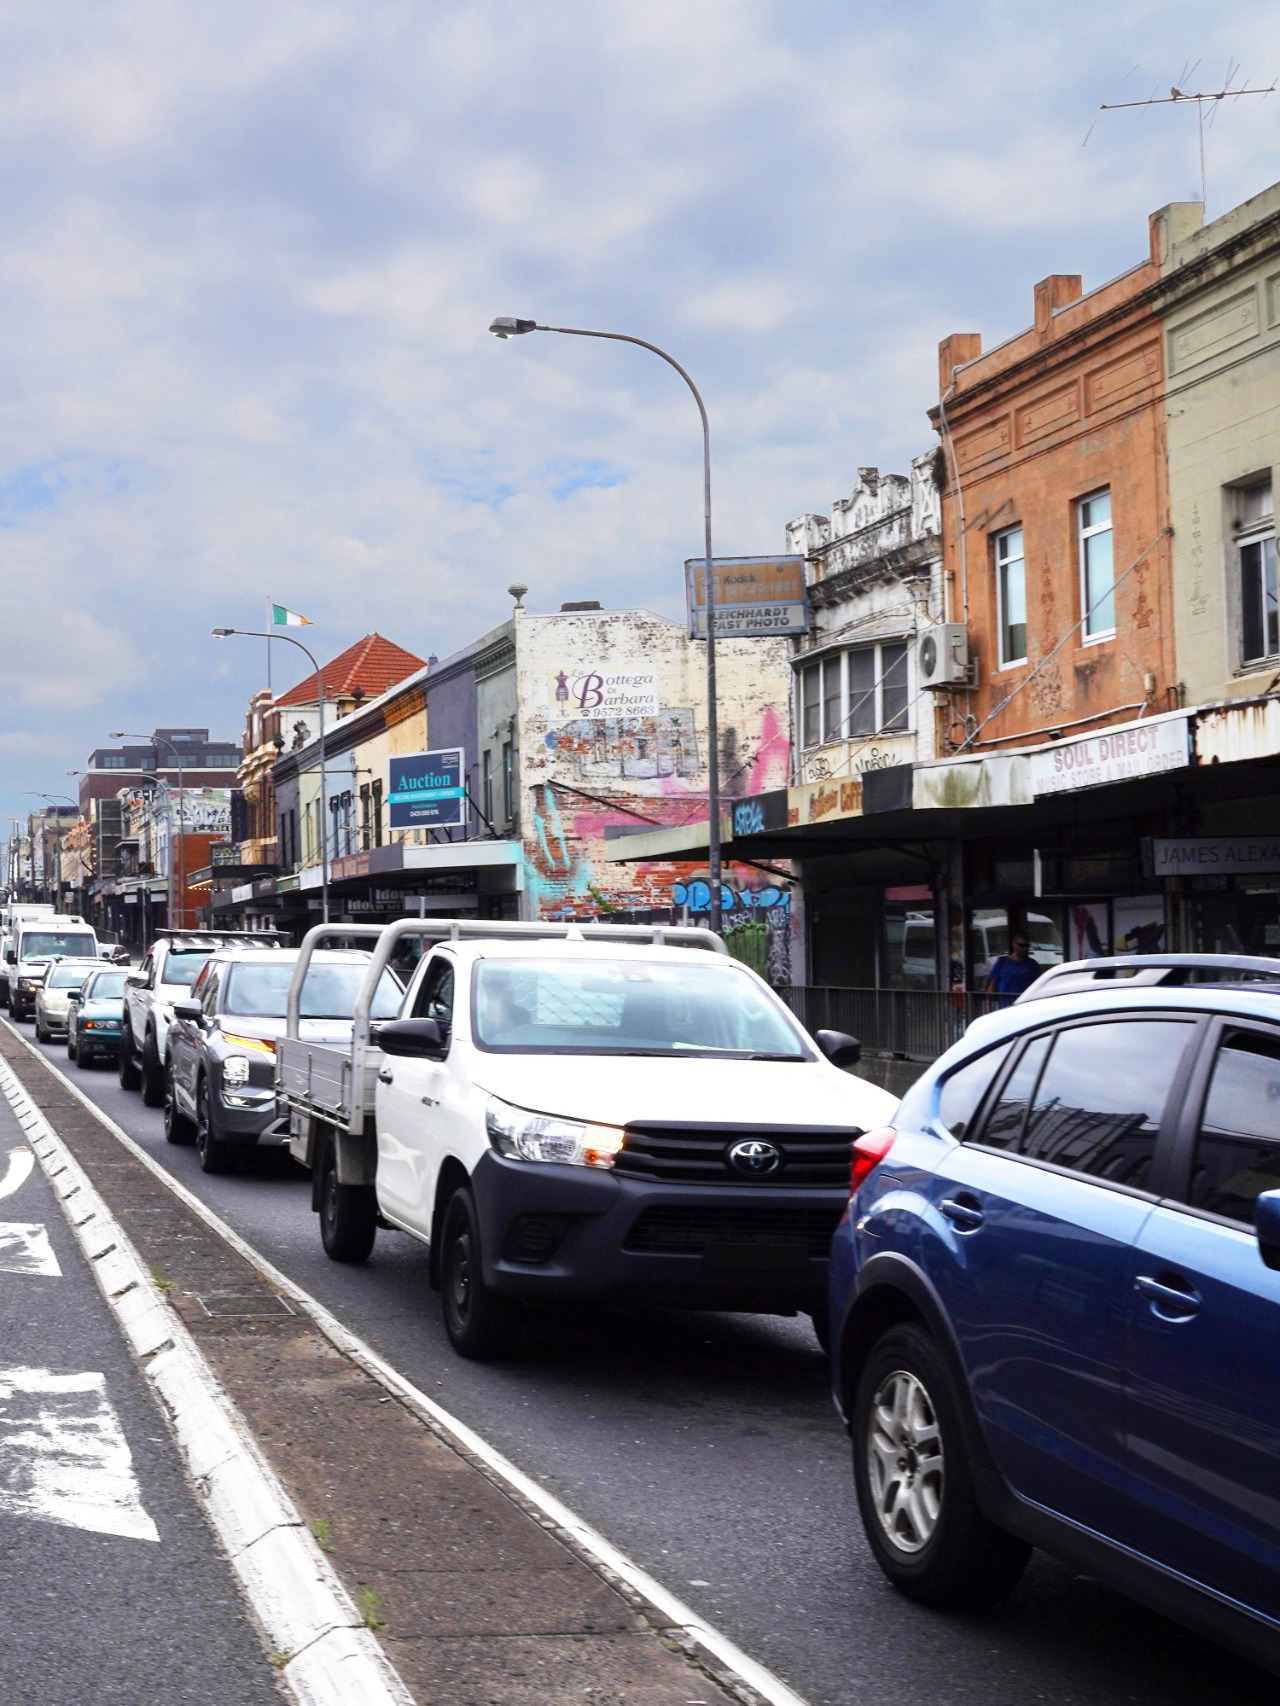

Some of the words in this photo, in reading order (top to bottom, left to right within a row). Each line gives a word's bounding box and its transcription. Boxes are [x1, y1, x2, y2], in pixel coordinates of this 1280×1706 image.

[723, 575, 756, 585] Kodak
[712, 607, 789, 621] LEICHHARDT
[745, 617, 790, 629] PHOTO
[593, 706, 622, 717] 9572
[625, 705, 655, 716] 8663
[1053, 744, 1094, 773] SOUL
[1098, 725, 1160, 762] DIRECT
[398, 772, 451, 790] Auction
[1037, 773, 1068, 797] MUSIC
[1070, 766, 1102, 789] STORE
[1116, 758, 1142, 779] MAIL
[1146, 750, 1185, 773] ORDER
[1159, 847, 1219, 865] JAMES
